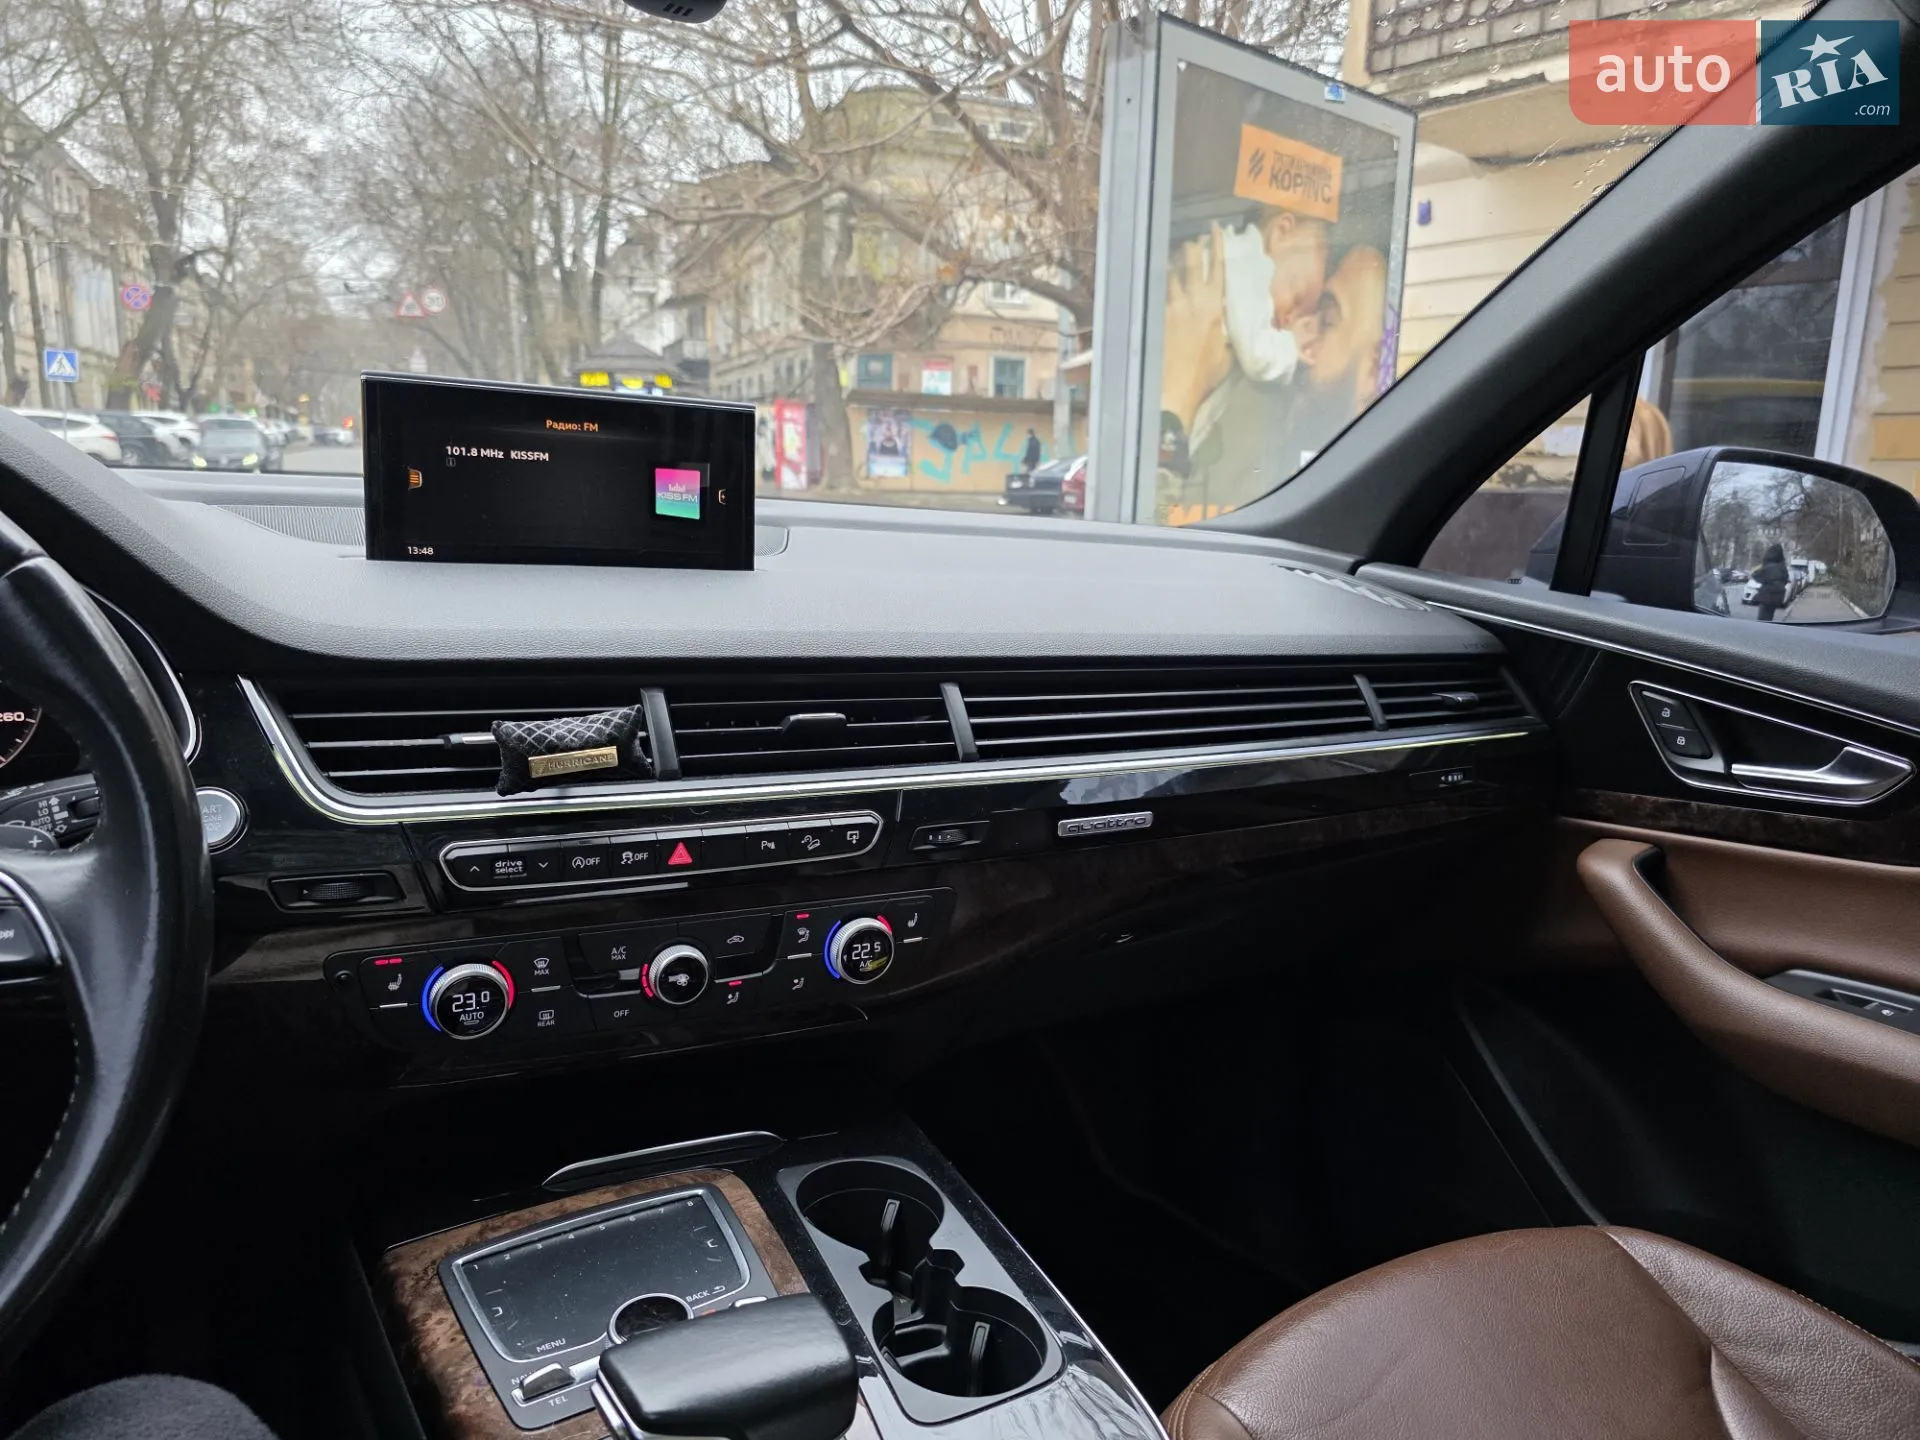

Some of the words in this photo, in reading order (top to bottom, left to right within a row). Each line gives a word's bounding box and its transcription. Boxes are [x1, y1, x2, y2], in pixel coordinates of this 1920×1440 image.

[545, 419, 582, 431] Радио:
[583, 422, 599, 432] FM
[446, 445, 478, 457] 101.8
[480, 448, 504, 459] MHz
[510, 450, 549, 461] KISSFM
[656, 491, 682, 501] KISS
[682, 493, 698, 503] FM
[407, 546, 434, 555] 13:48
[548, 752, 614, 771] HURRICANE
[38, 800, 48, 808] HI
[37, 808, 49, 817] LO
[30, 816, 51, 827] AUTO
[1066, 817, 1147, 833] quattro
[634, 852, 649, 861] OFF
[495, 859, 523, 868] drive
[495, 866, 523, 874] select
[611, 946, 627, 955] A/C
[534, 968, 550, 976] MAX
[459, 1011, 485, 1021] AUTO
[613, 1009, 630, 1018] OFF
[685, 1290, 711, 1302] BACK
[536, 1338, 566, 1353] MENU
[548, 1395, 568, 1407] TEL
